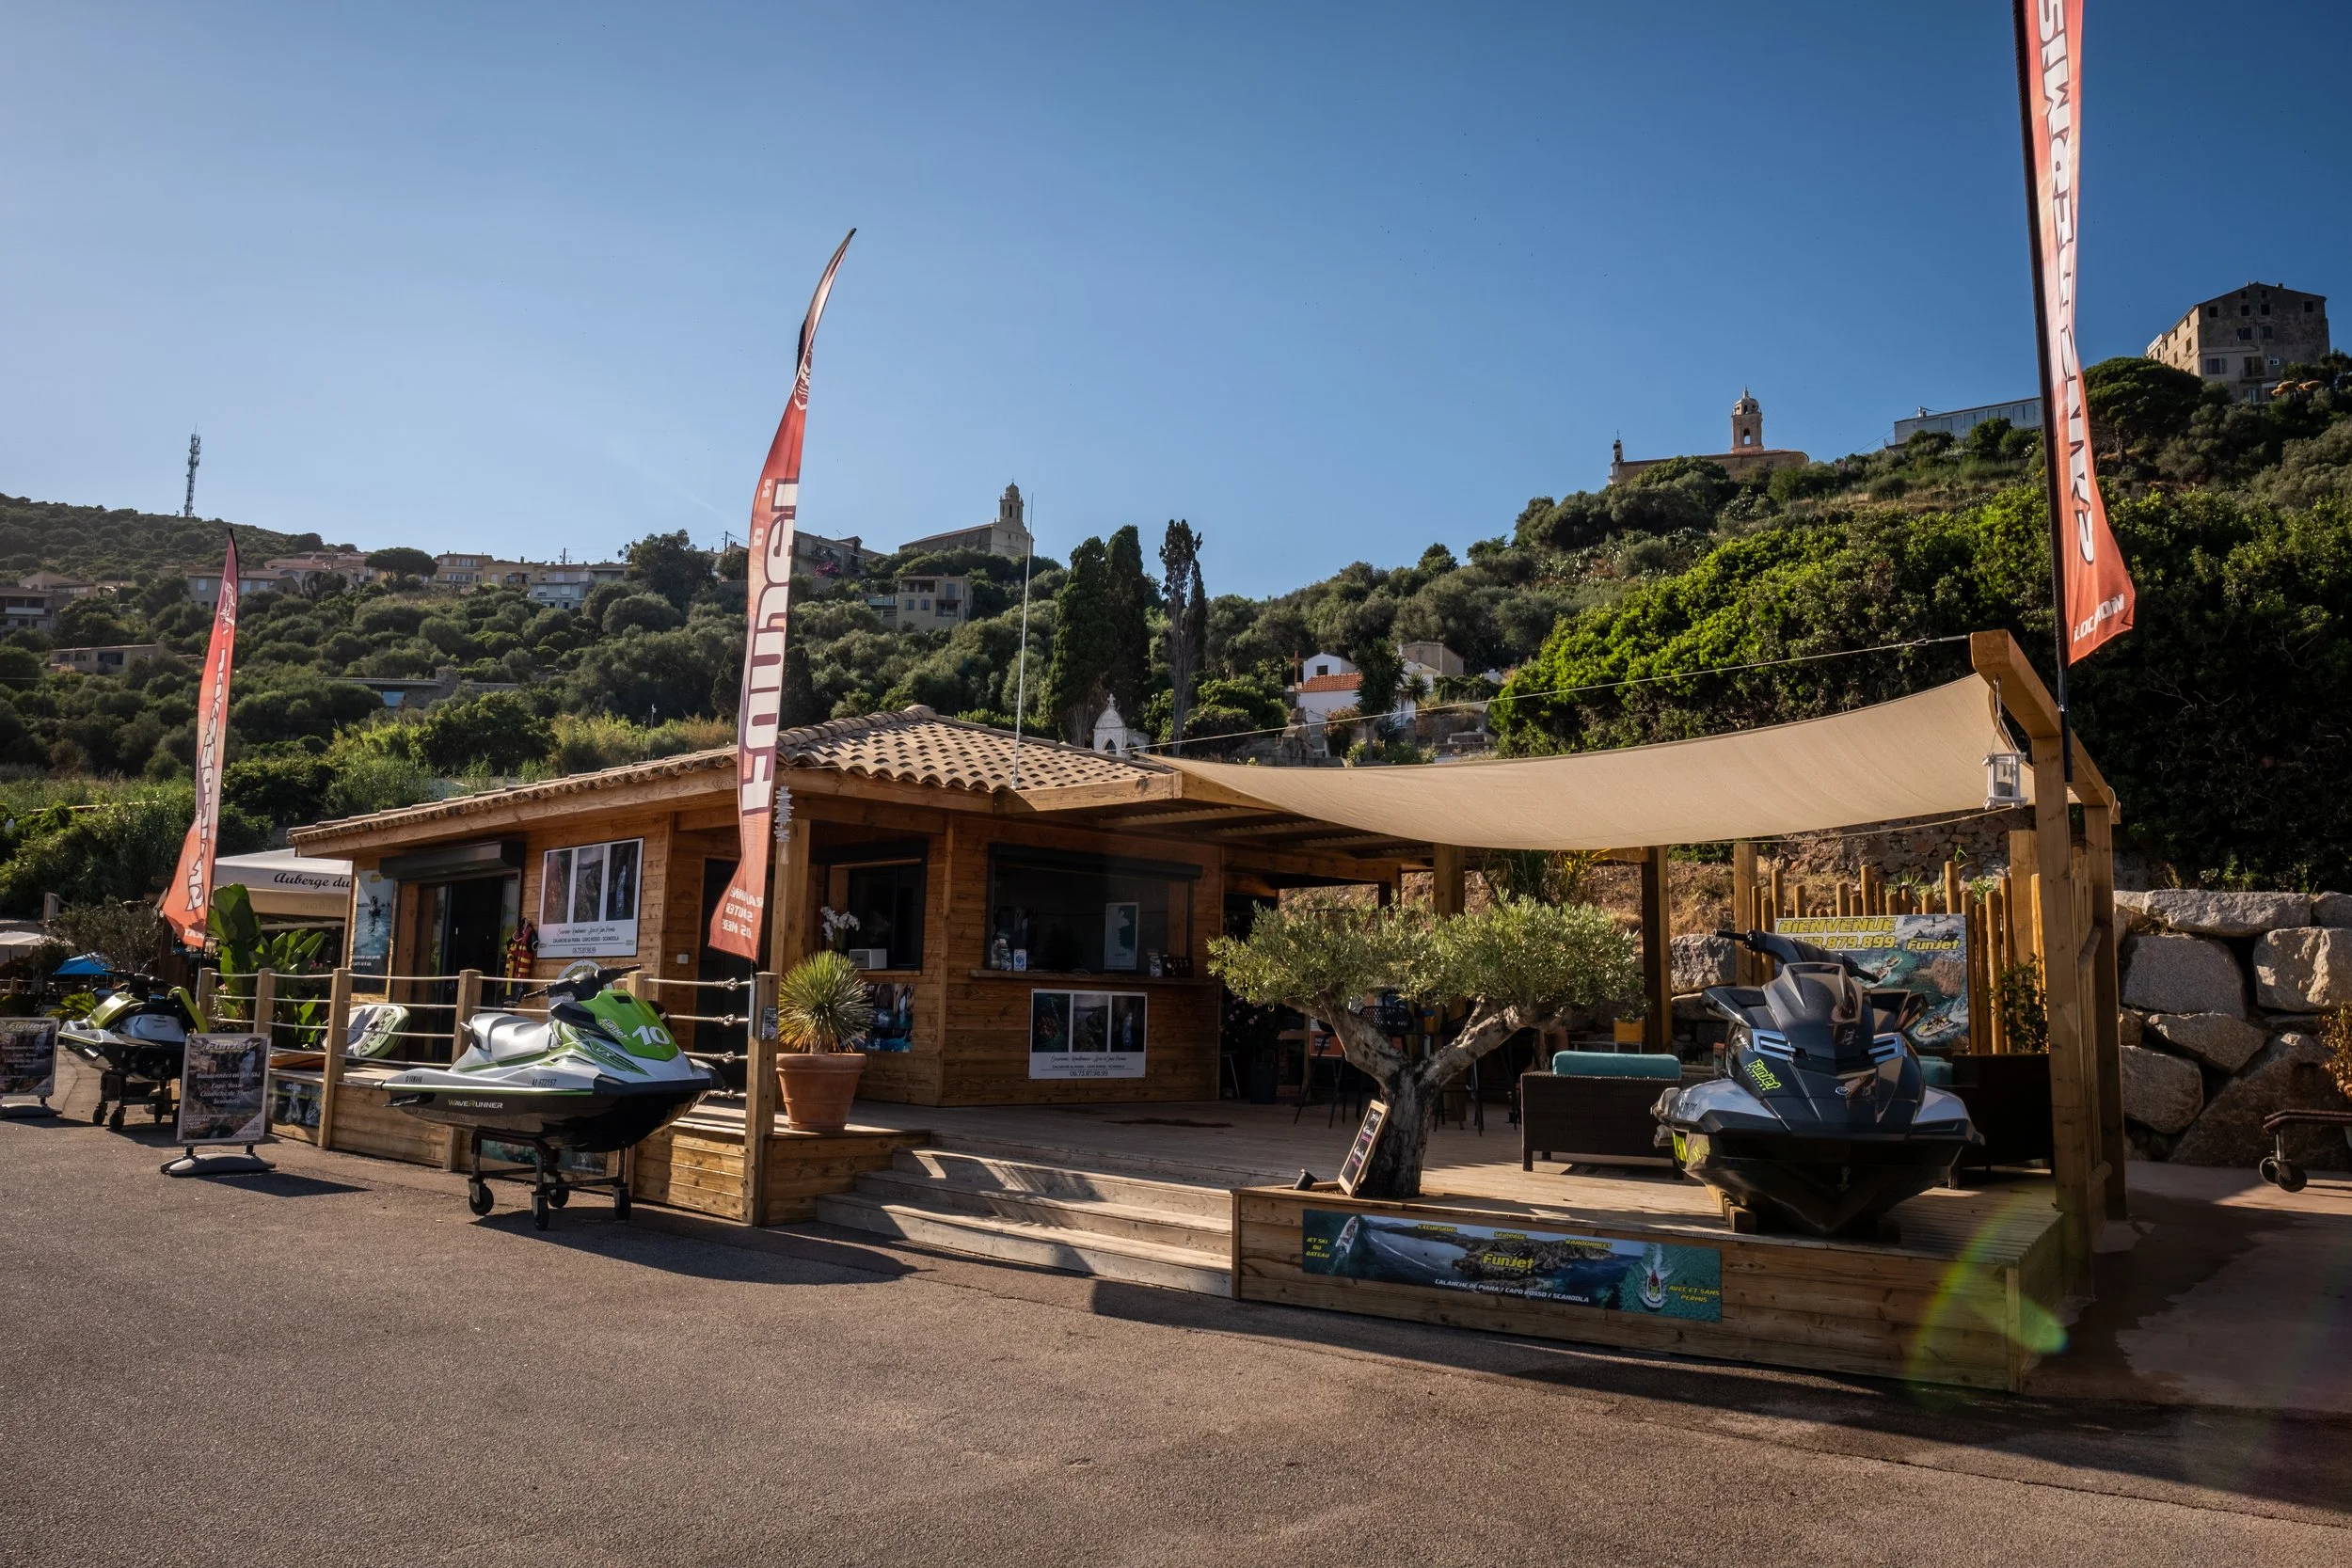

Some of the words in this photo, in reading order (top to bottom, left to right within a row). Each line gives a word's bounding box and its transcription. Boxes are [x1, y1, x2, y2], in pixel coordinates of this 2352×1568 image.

[274, 872, 330, 890] Auberge
[332, 877, 352, 889] du
[631, 1024, 671, 1046] 10
[1417, 1224, 1457, 1233] EXCURSIONS
[1435, 1278, 1468, 1289] CALANCHE
[1478, 1284, 1500, 1292] PIANA
[1505, 1288, 1523, 1296] CAPO
[1524, 1290, 1547, 1298] ROSSO
[1552, 1292, 1590, 1304] SCANDOLA
[1699, 1288, 1721, 1296] SANS
[1680, 1294, 1708, 1303] PERMIS
